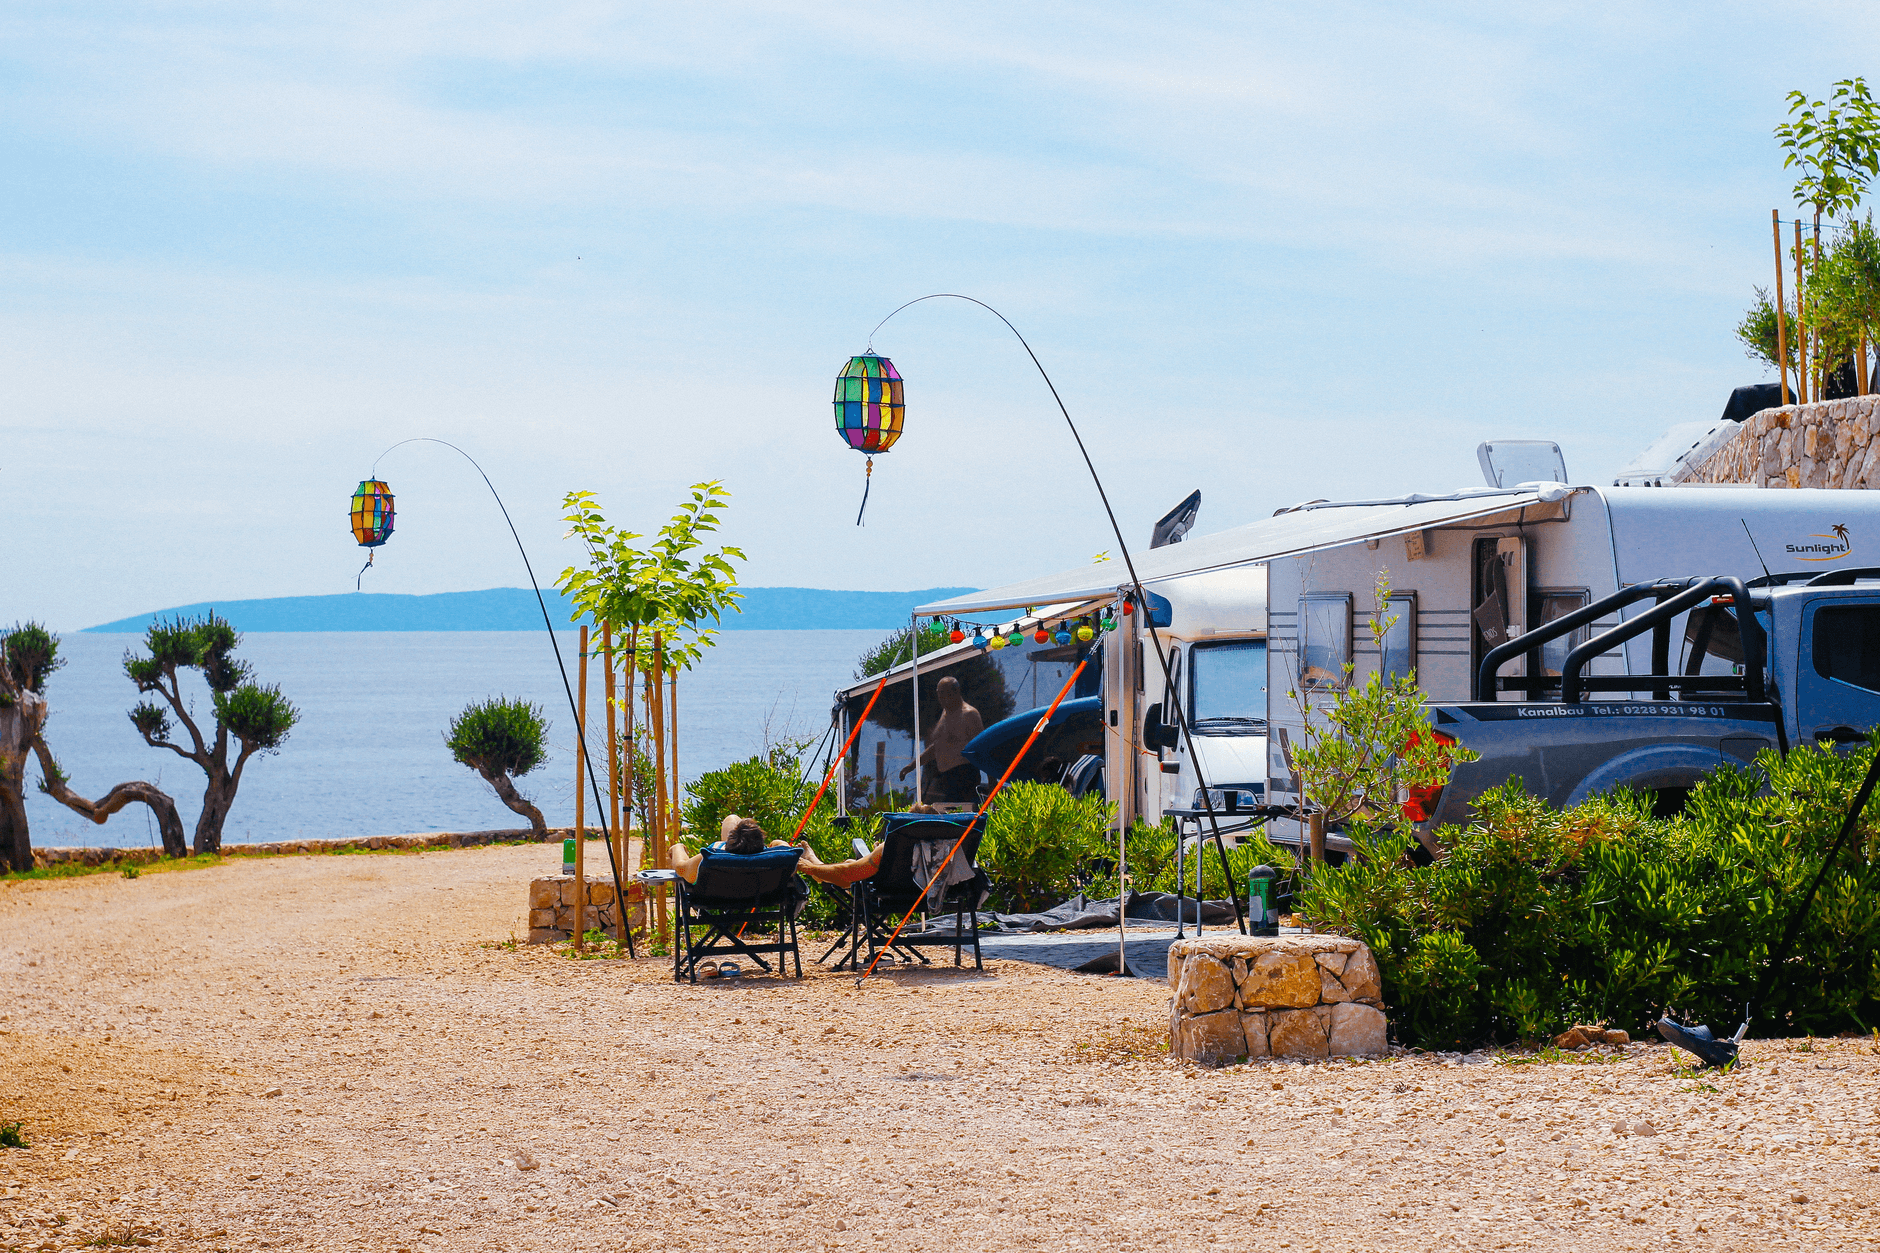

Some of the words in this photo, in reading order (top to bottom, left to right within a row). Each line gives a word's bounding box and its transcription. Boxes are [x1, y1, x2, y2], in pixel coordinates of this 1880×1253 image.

[1785, 544, 1846, 554] Sunlight
[1517, 706, 1584, 717] Kanalbau
[1591, 706, 1620, 715] Tel.:
[1623, 706, 1657, 714] 0228
[1660, 706, 1684, 714] 931
[1689, 706, 1706, 715] 98
[1709, 706, 1725, 716] 01
